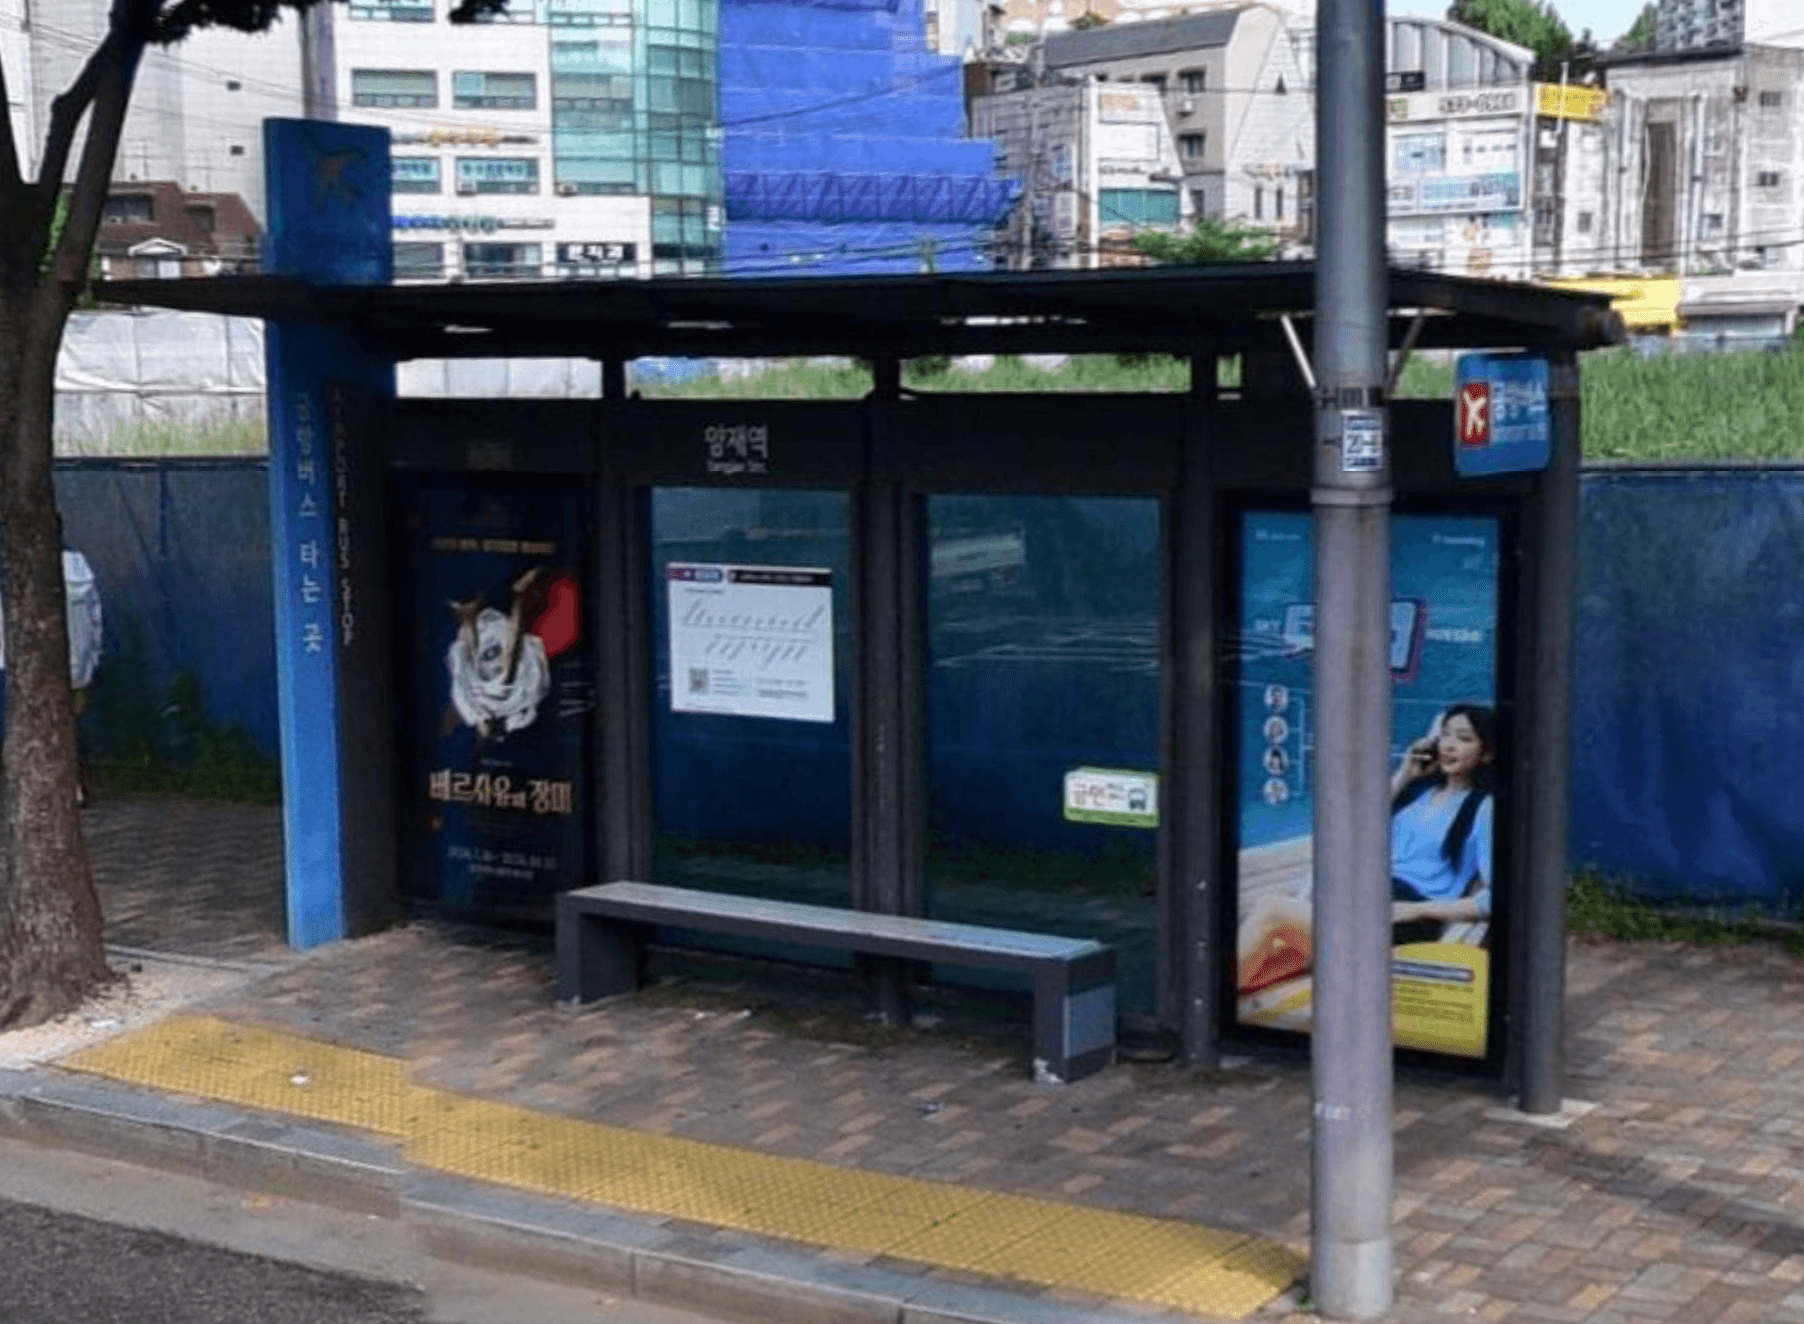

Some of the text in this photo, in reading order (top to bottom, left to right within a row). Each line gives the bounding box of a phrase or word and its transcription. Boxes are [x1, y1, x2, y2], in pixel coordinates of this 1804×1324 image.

[299, 539, 322, 604] 타는
[303, 622, 324, 654] 곳
[526, 778, 573, 815] 장미
